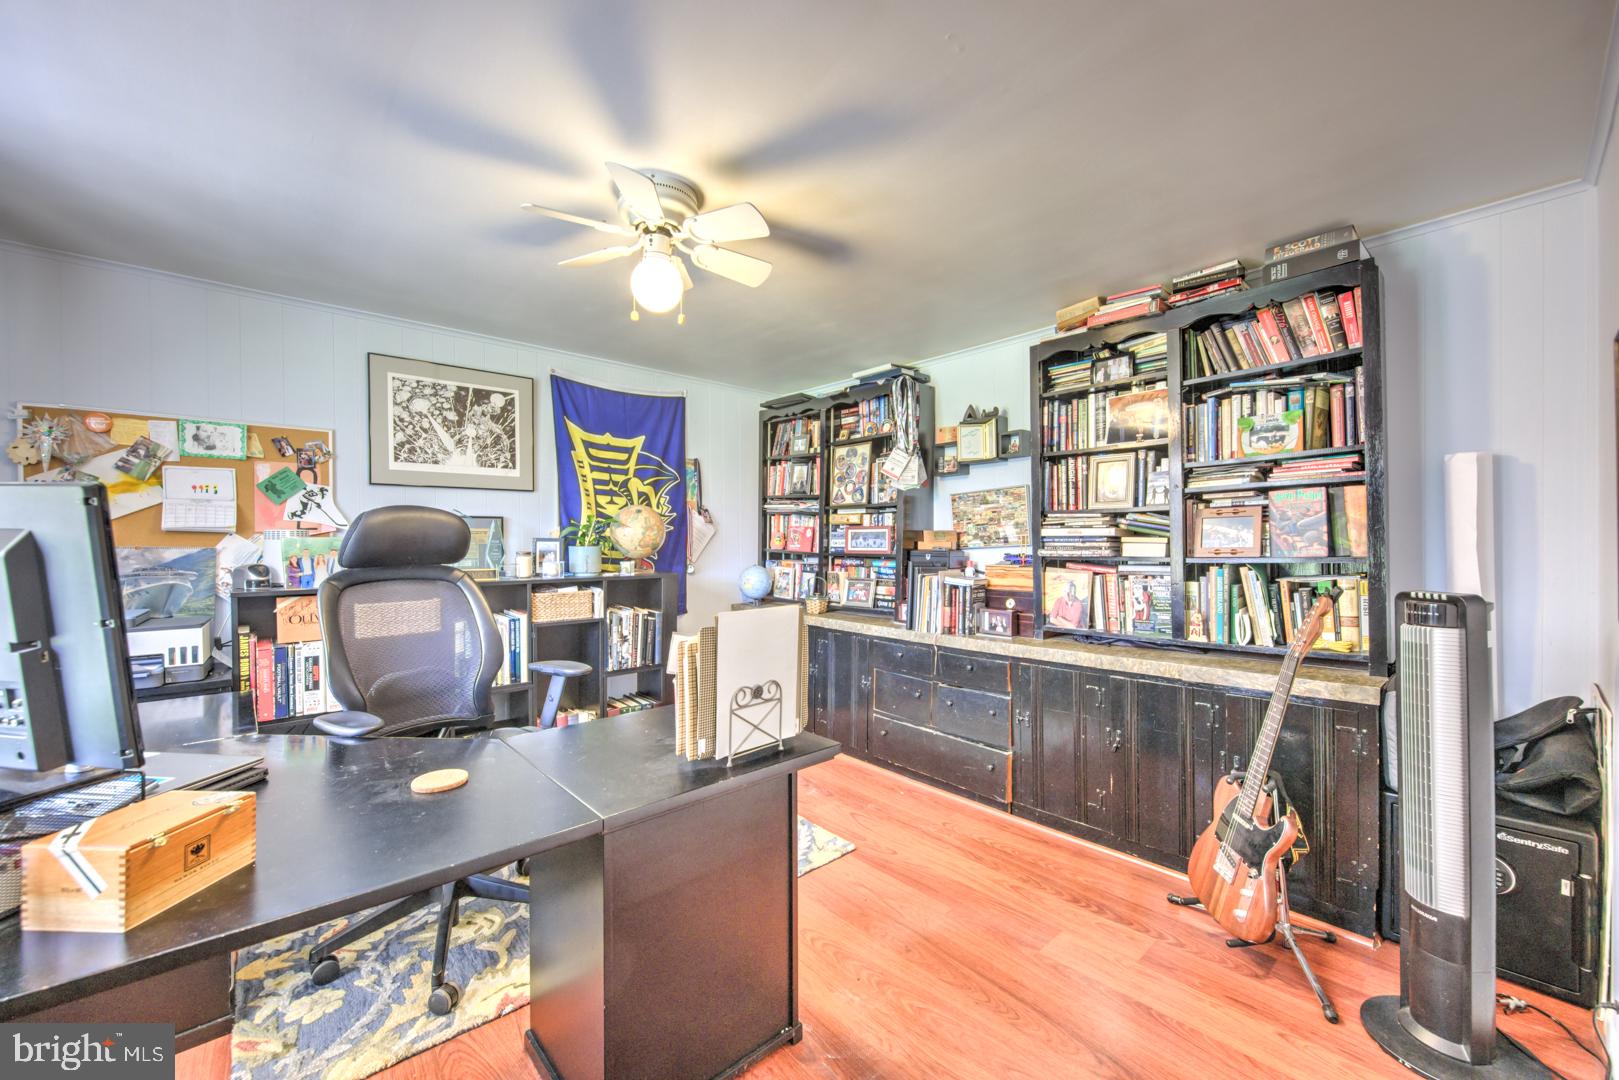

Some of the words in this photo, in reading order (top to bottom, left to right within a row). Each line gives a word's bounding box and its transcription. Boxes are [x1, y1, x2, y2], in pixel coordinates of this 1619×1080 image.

[1272, 242, 1321, 261] FITZGERALD
[1284, 235, 1321, 251] SCOTT
[239, 635, 250, 657] JAMES
[239, 658, 250, 676] BOND
[1505, 834, 1569, 855] SentrySafe
